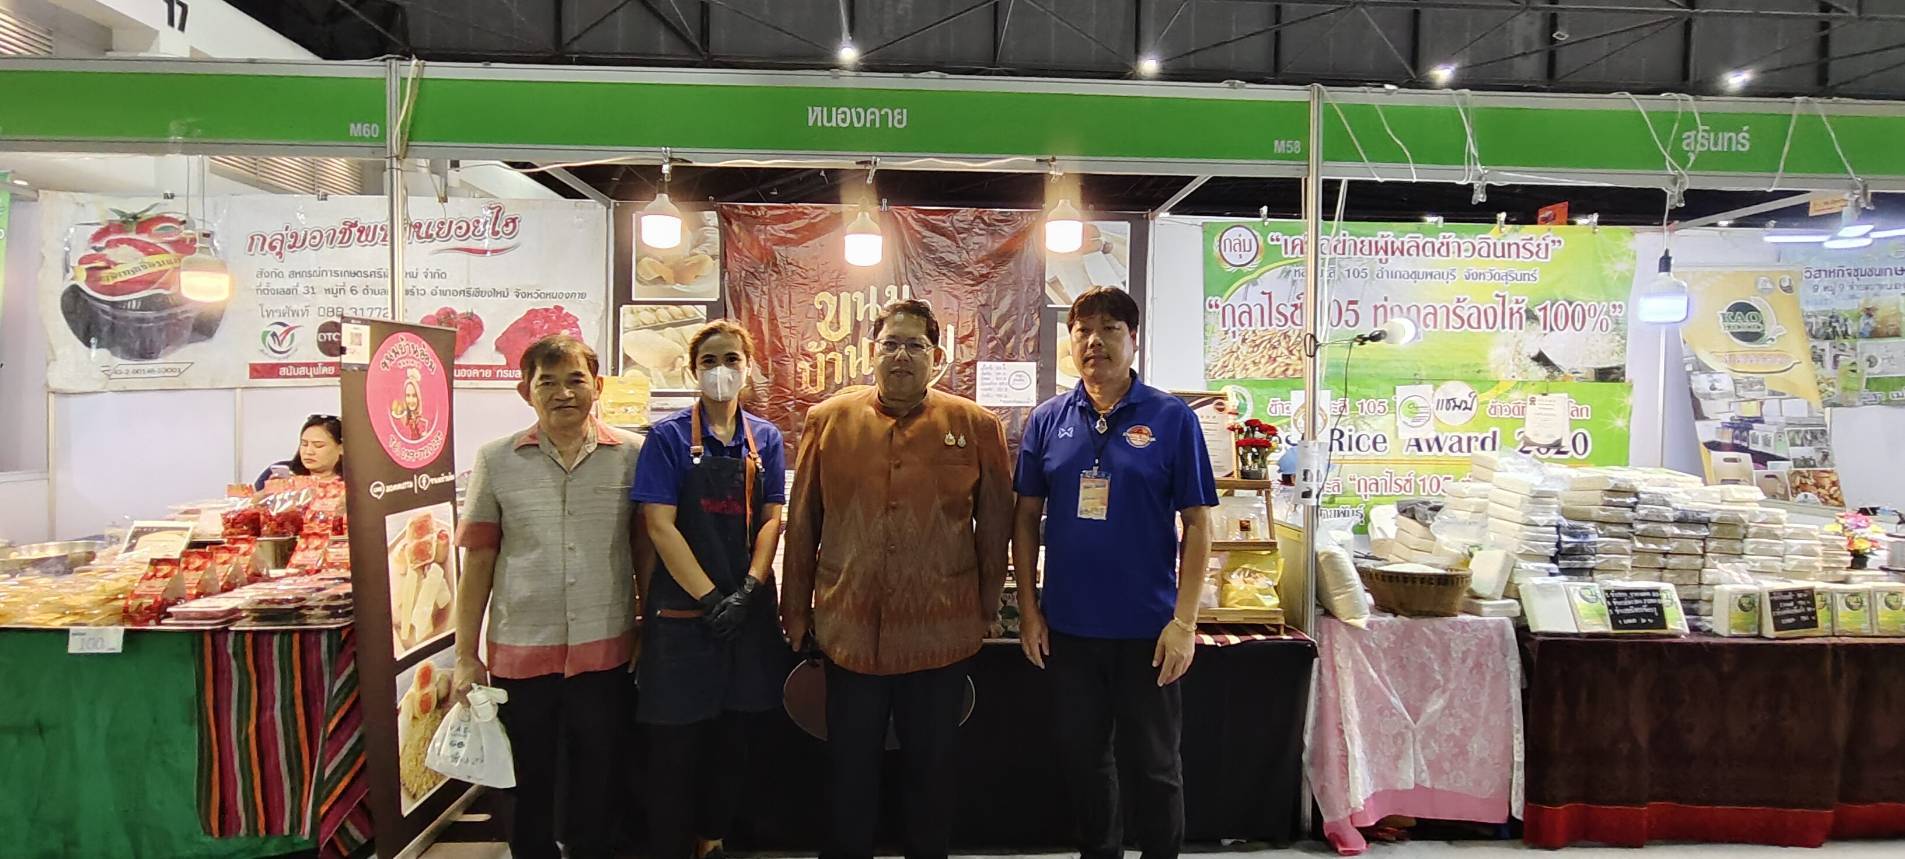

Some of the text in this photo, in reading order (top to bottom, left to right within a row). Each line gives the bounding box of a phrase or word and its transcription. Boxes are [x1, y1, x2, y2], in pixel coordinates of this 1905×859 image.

[807, 105, 908, 129] หนองคาย
[349, 122, 381, 139] M60
[1273, 139, 1301, 154] M58
[1682, 125, 1751, 161] สุรินทร์
[1223, 233, 1252, 260] กลุ่ม
[1345, 268, 1369, 280] 105
[1464, 268, 1538, 285] จังหวัดสุรินทร์
[302, 285, 316, 295] 31
[349, 285, 359, 296] 6
[278, 364, 335, 377] สนับสนุนโดย
[1357, 400, 1387, 416] 105
[1330, 427, 1388, 453] Rice
[1405, 430, 1498, 454] Award
